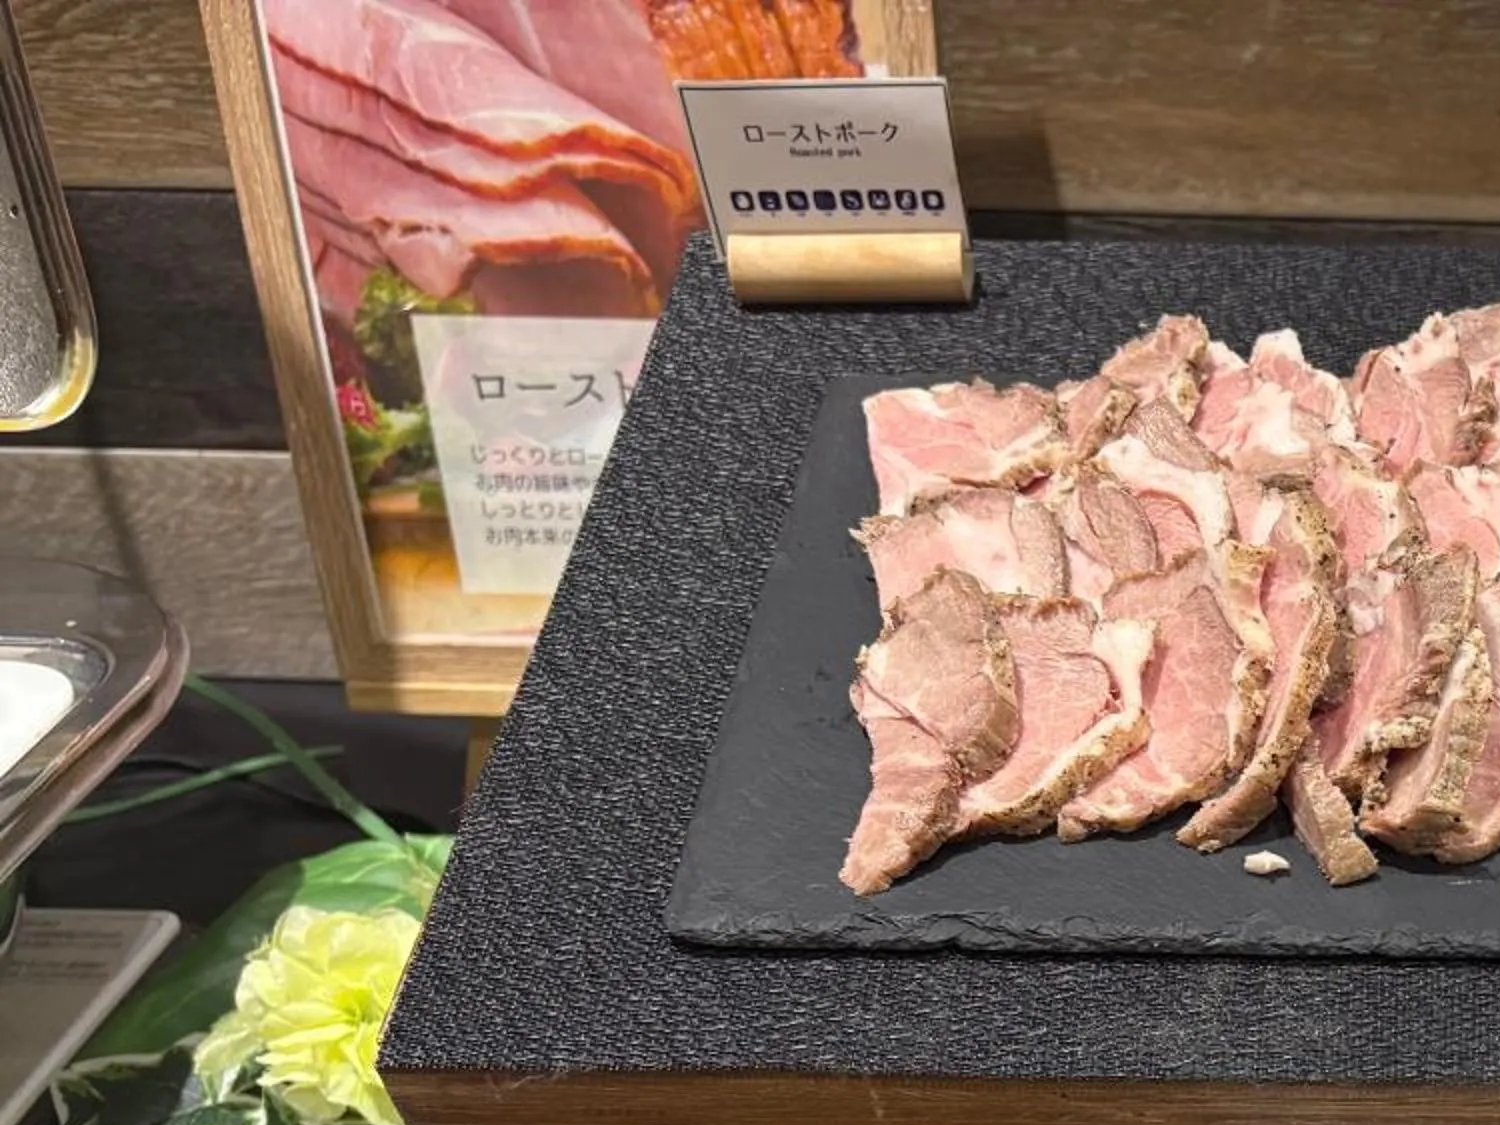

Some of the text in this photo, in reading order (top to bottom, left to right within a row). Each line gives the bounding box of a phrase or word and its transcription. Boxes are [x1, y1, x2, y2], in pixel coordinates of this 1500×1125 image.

[743, 122, 898, 143] ローストポーク
